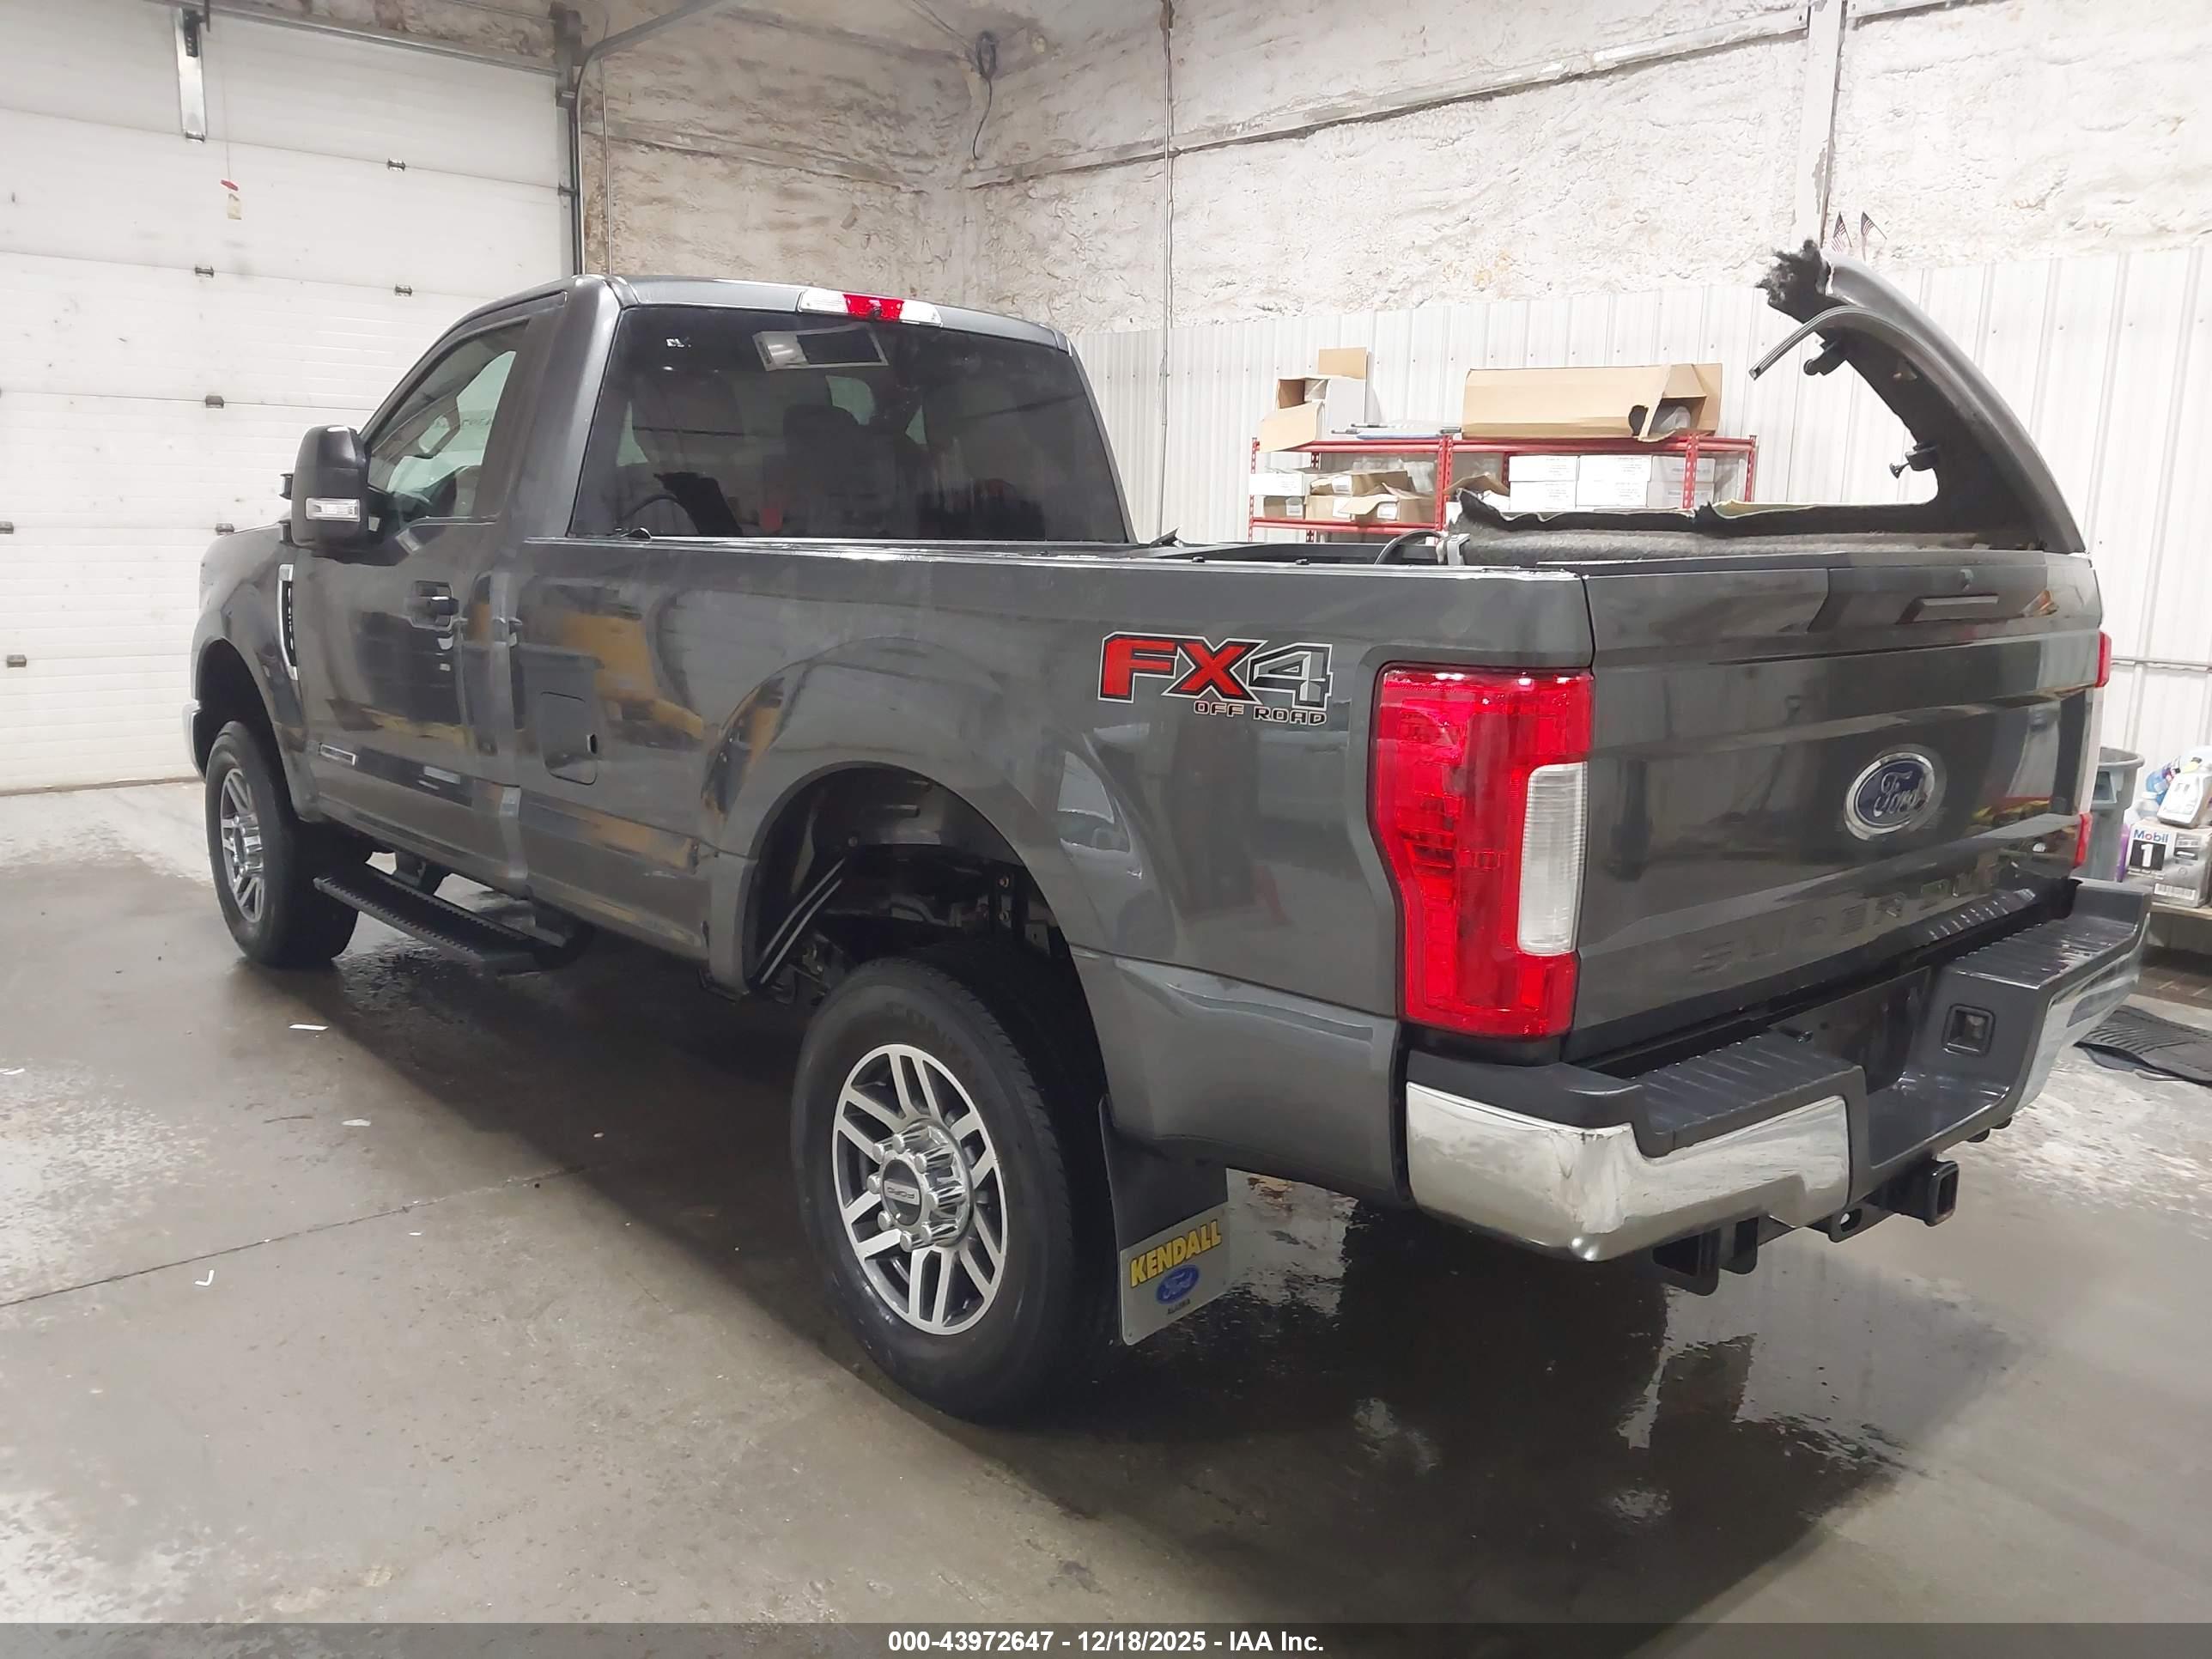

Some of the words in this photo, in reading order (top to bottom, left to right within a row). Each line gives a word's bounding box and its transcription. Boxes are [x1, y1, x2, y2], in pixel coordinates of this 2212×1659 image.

[1097, 631, 1334, 712] FX4
[1194, 701, 1244, 717] OFF
[1253, 707, 1327, 726] ROAD
[1872, 770, 1928, 817] Ford
[2133, 829, 2169, 844] Mobil
[2139, 843, 2154, 868] 1
[1130, 1218, 1223, 1288] KENDALL
